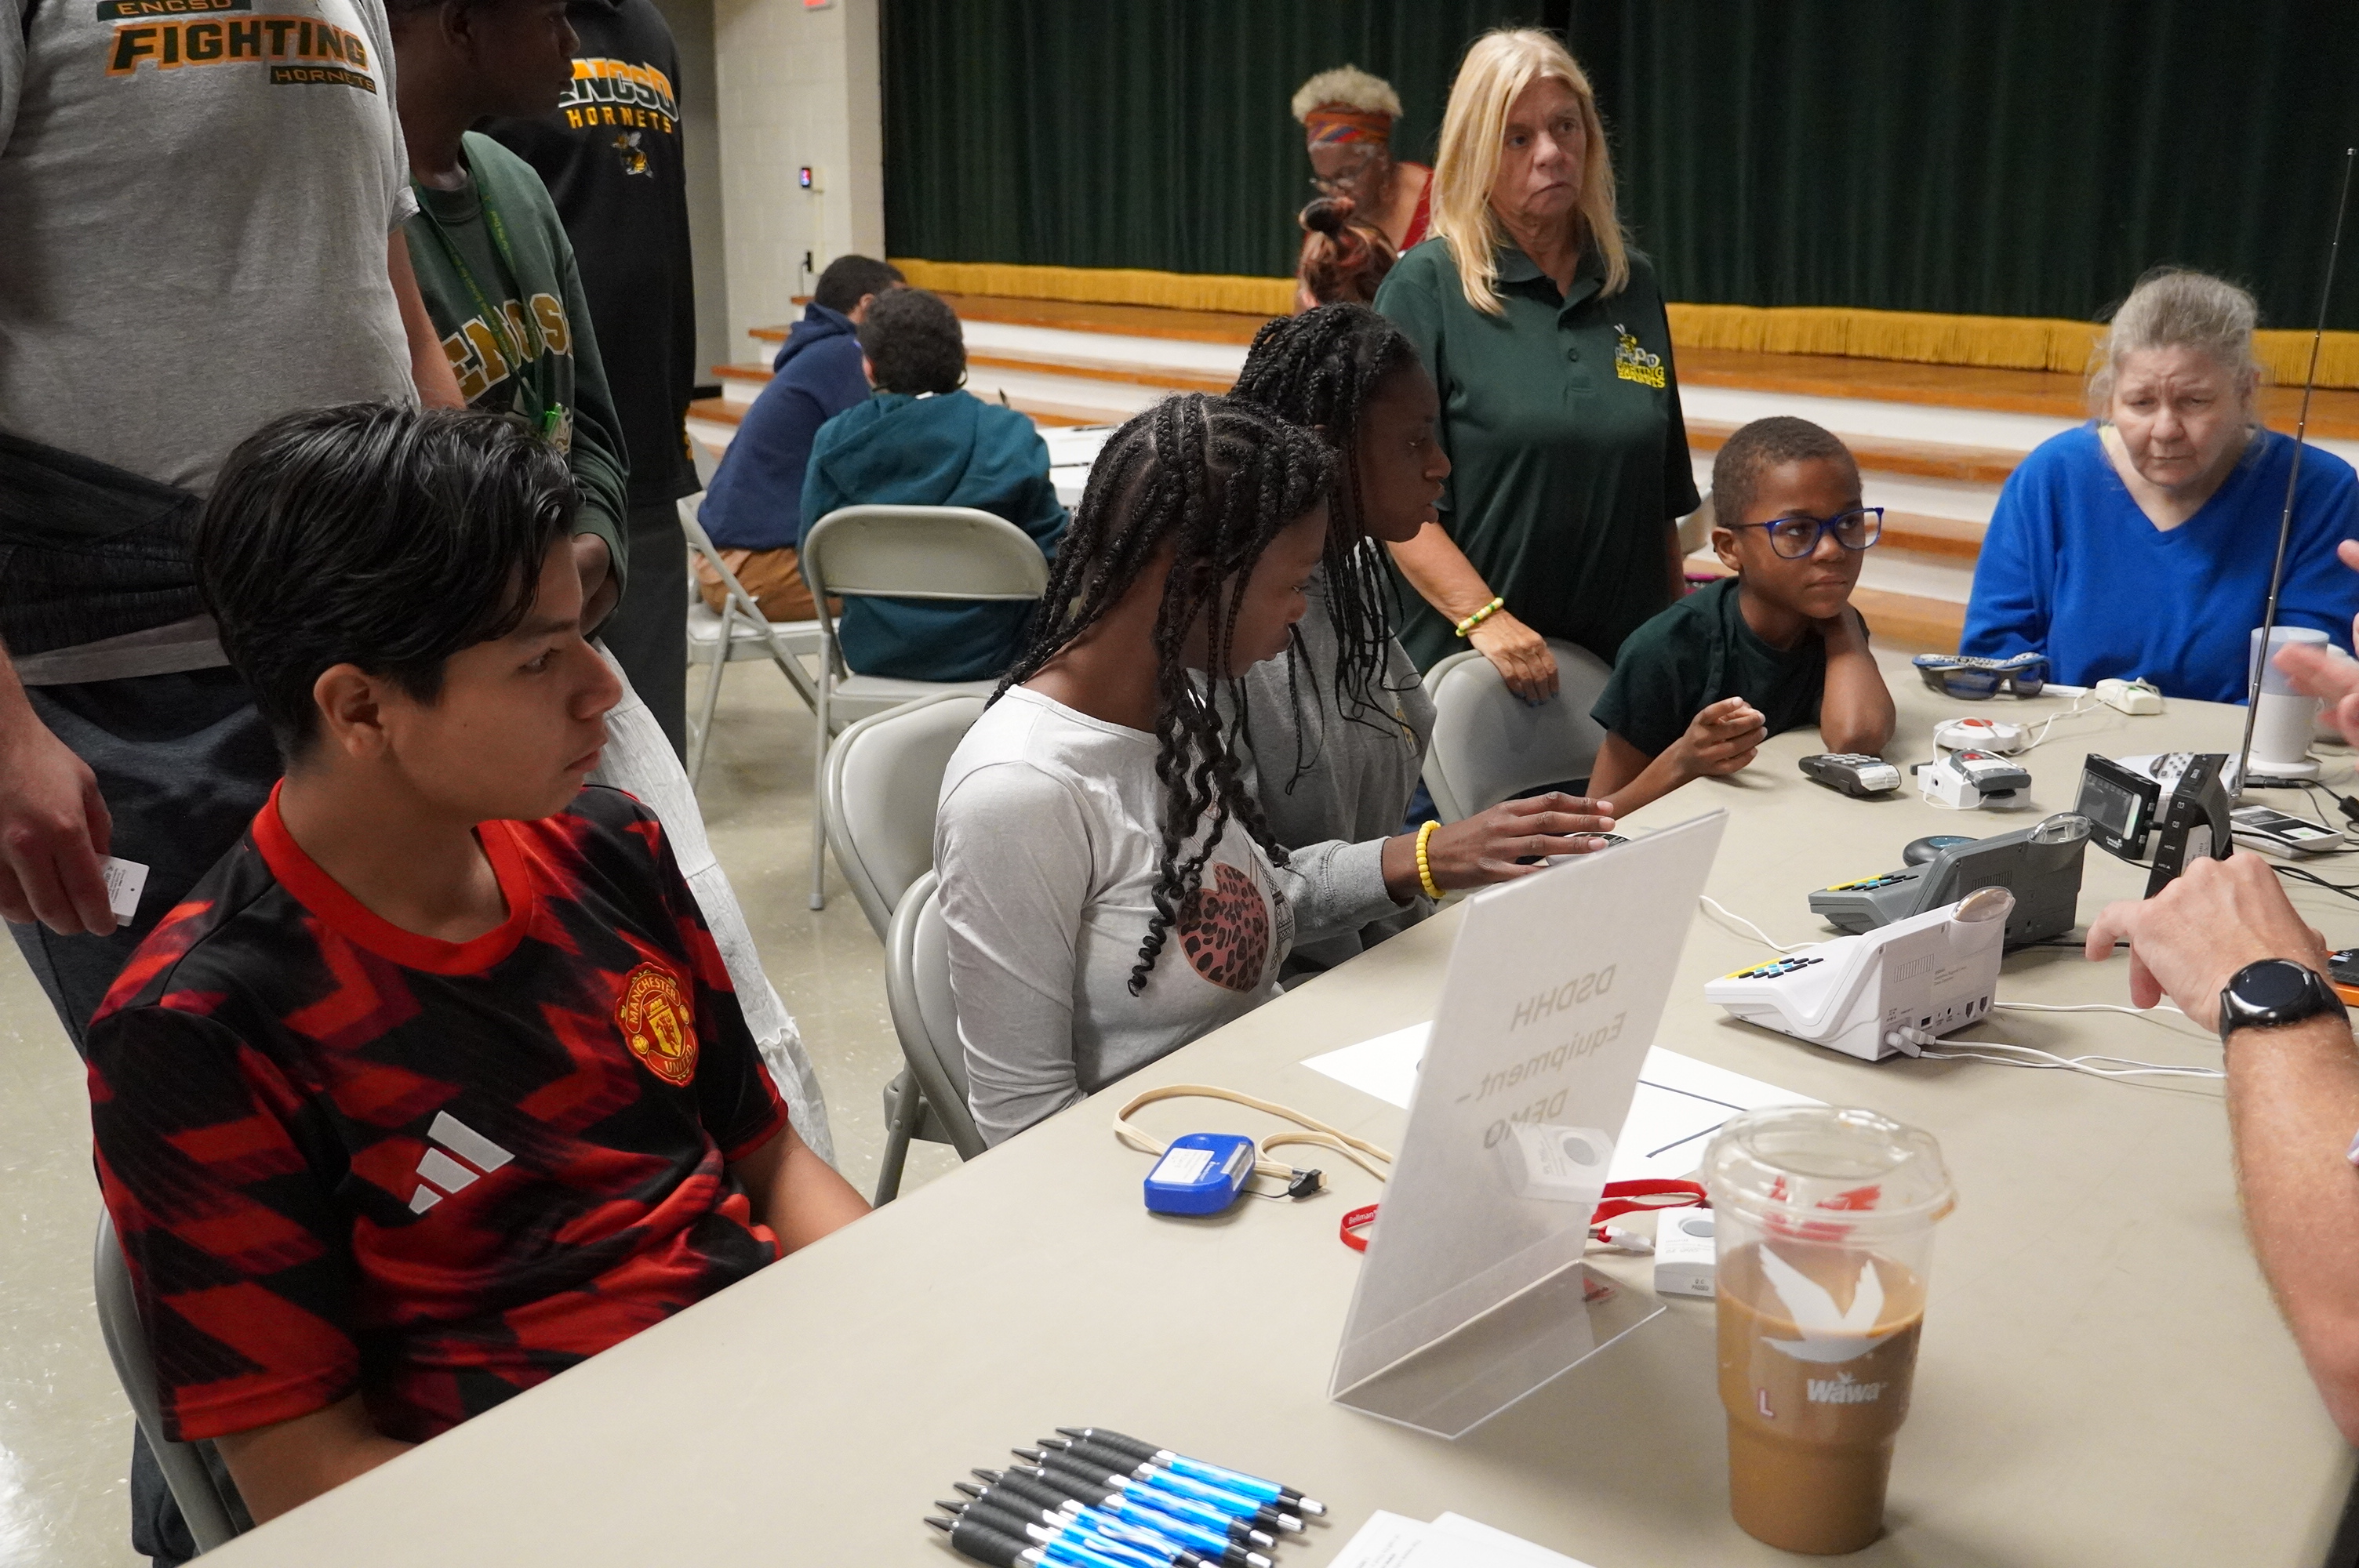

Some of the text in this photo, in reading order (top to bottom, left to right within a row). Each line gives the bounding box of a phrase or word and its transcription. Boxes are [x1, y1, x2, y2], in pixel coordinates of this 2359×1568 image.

[117, 0, 232, 15] ENCSD
[107, 16, 369, 76] FIGHTING
[275, 68, 376, 92] HORNETS
[565, 107, 673, 134] HORNETS
[441, 292, 573, 405] ENCS
[629, 977, 677, 1025] MANCHESTER
[663, 1044, 694, 1073] UNITED
[1758, 1388, 1775, 1418] L
[1807, 1377, 1881, 1404] Wawa
